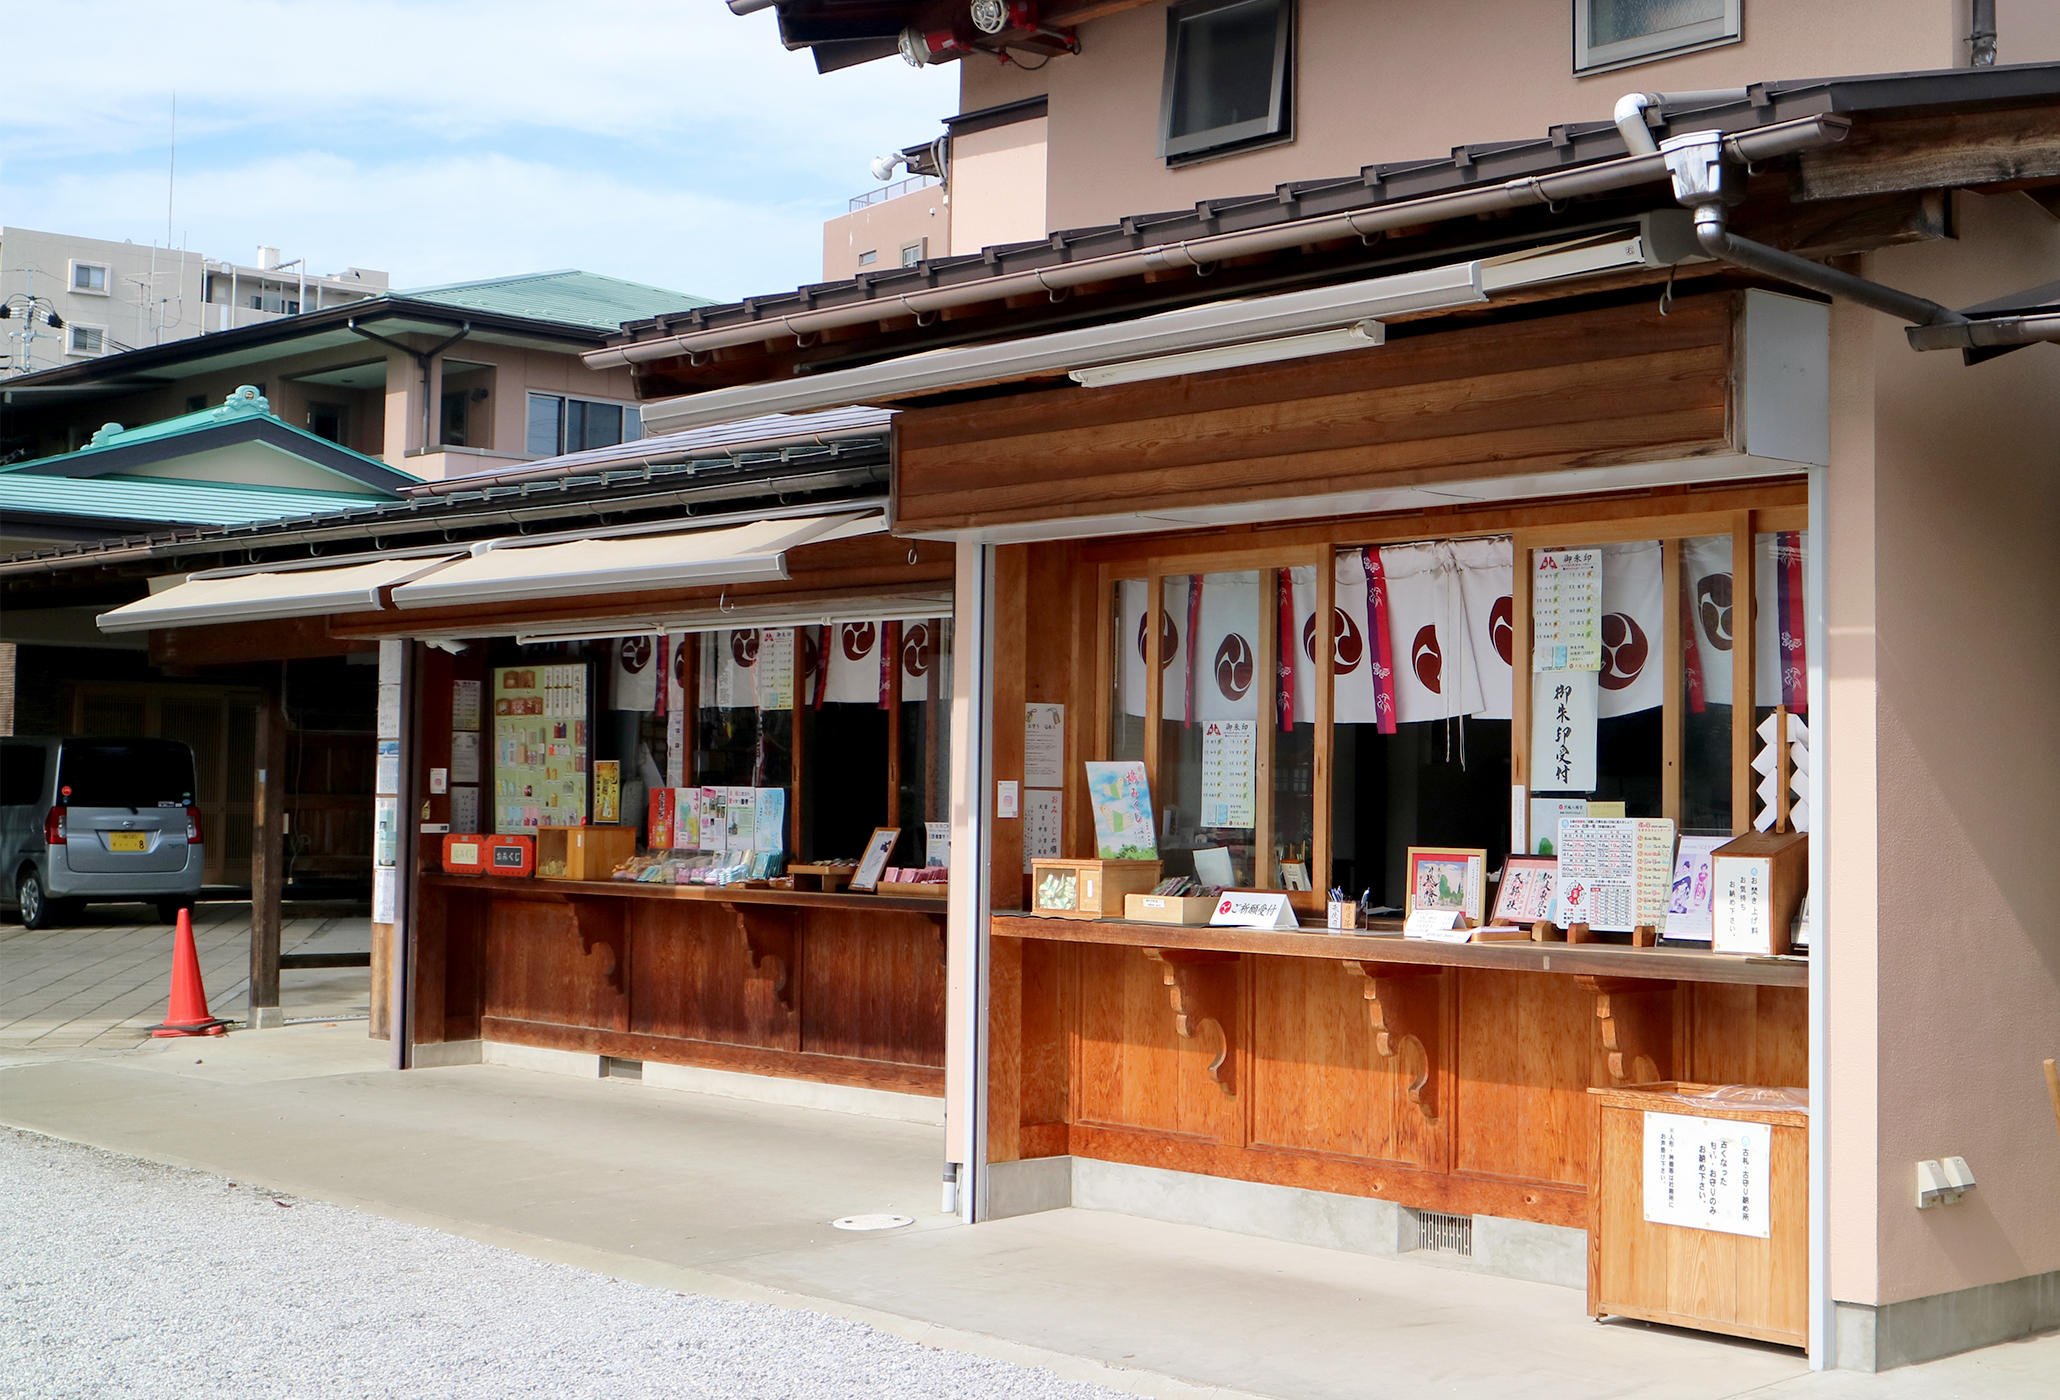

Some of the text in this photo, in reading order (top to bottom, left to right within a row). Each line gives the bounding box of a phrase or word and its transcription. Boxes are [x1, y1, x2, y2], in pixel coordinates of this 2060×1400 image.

[1563, 553, 1592, 563] 御朱印
[1225, 722, 1249, 731] 御朱印
[1554, 684, 1572, 783] 御朱印受付
[1126, 769, 1142, 823] 鳩みくじ
[496, 851, 521, 862] おみくじ
[1231, 902, 1277, 917] ご祈願受付
[1739, 876, 1747, 912] お気持ち
[1751, 877, 1759, 935] お焚き上げ料
[1698, 1145, 1706, 1204] お納め下さい。
[1720, 1141, 1728, 1186] 古くなった
